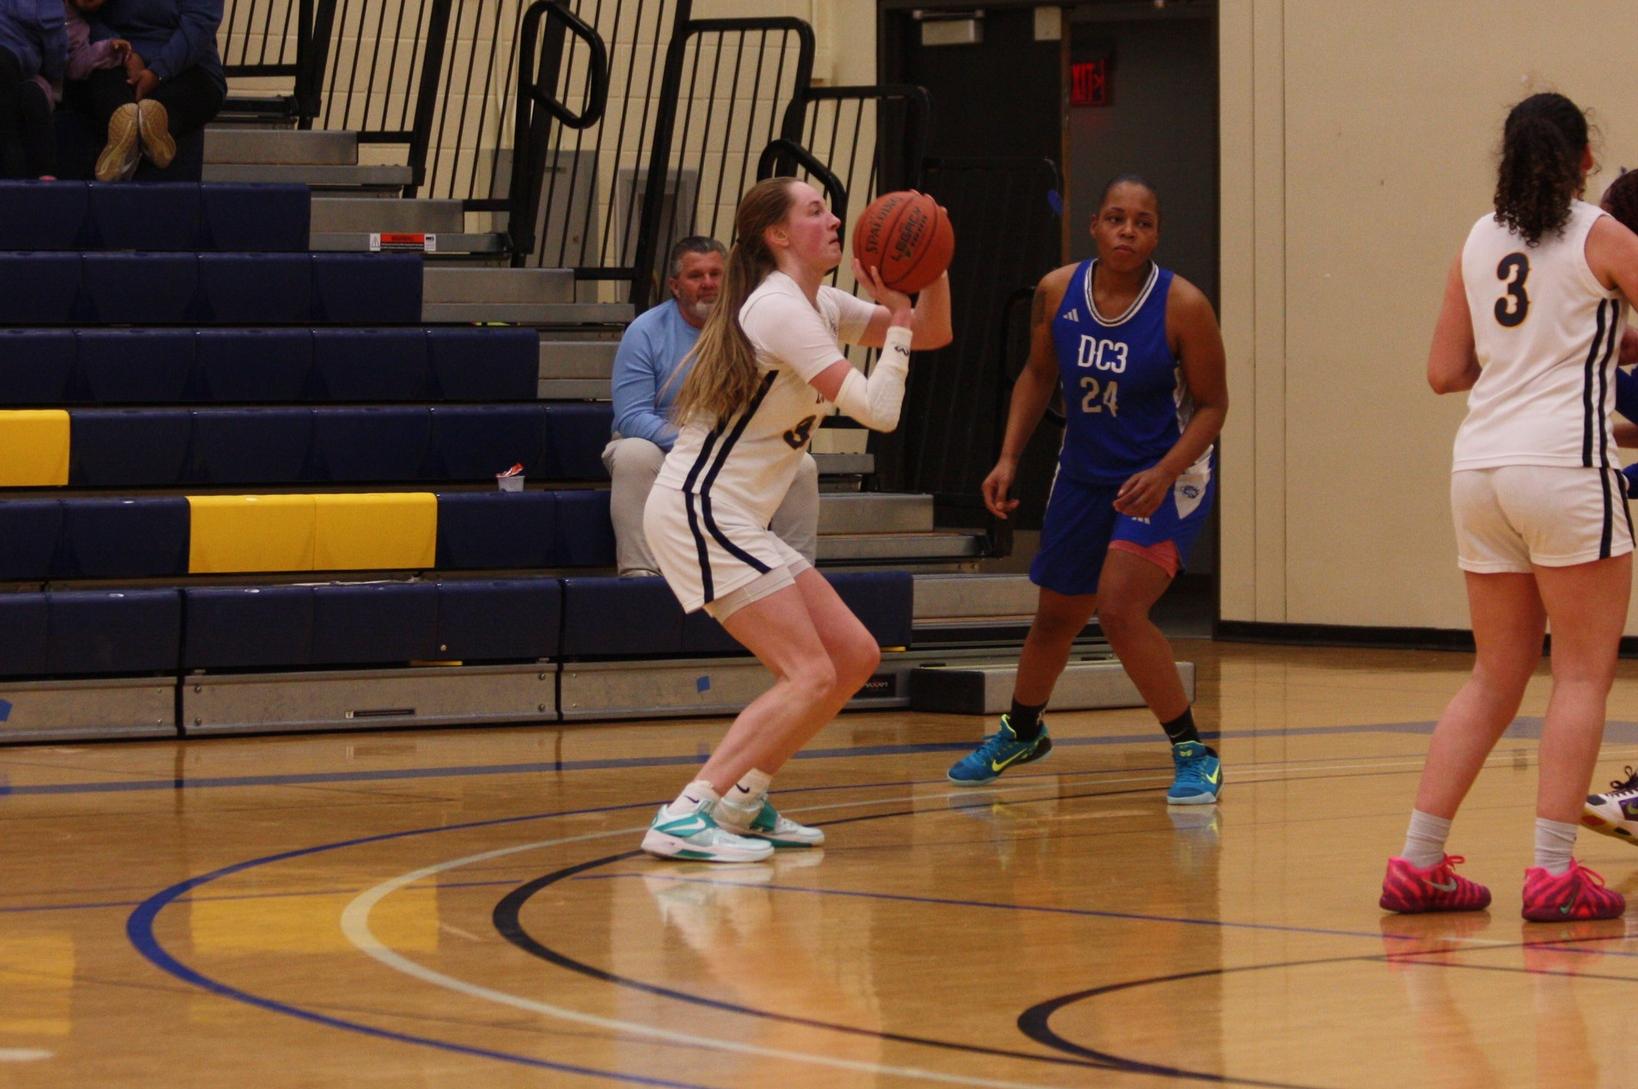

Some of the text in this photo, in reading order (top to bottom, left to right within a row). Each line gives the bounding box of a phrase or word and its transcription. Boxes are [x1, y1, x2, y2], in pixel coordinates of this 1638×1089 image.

[1493, 251, 1532, 328] 3
[1077, 333, 1129, 374] DC3
[1080, 376, 1119, 418] 24
